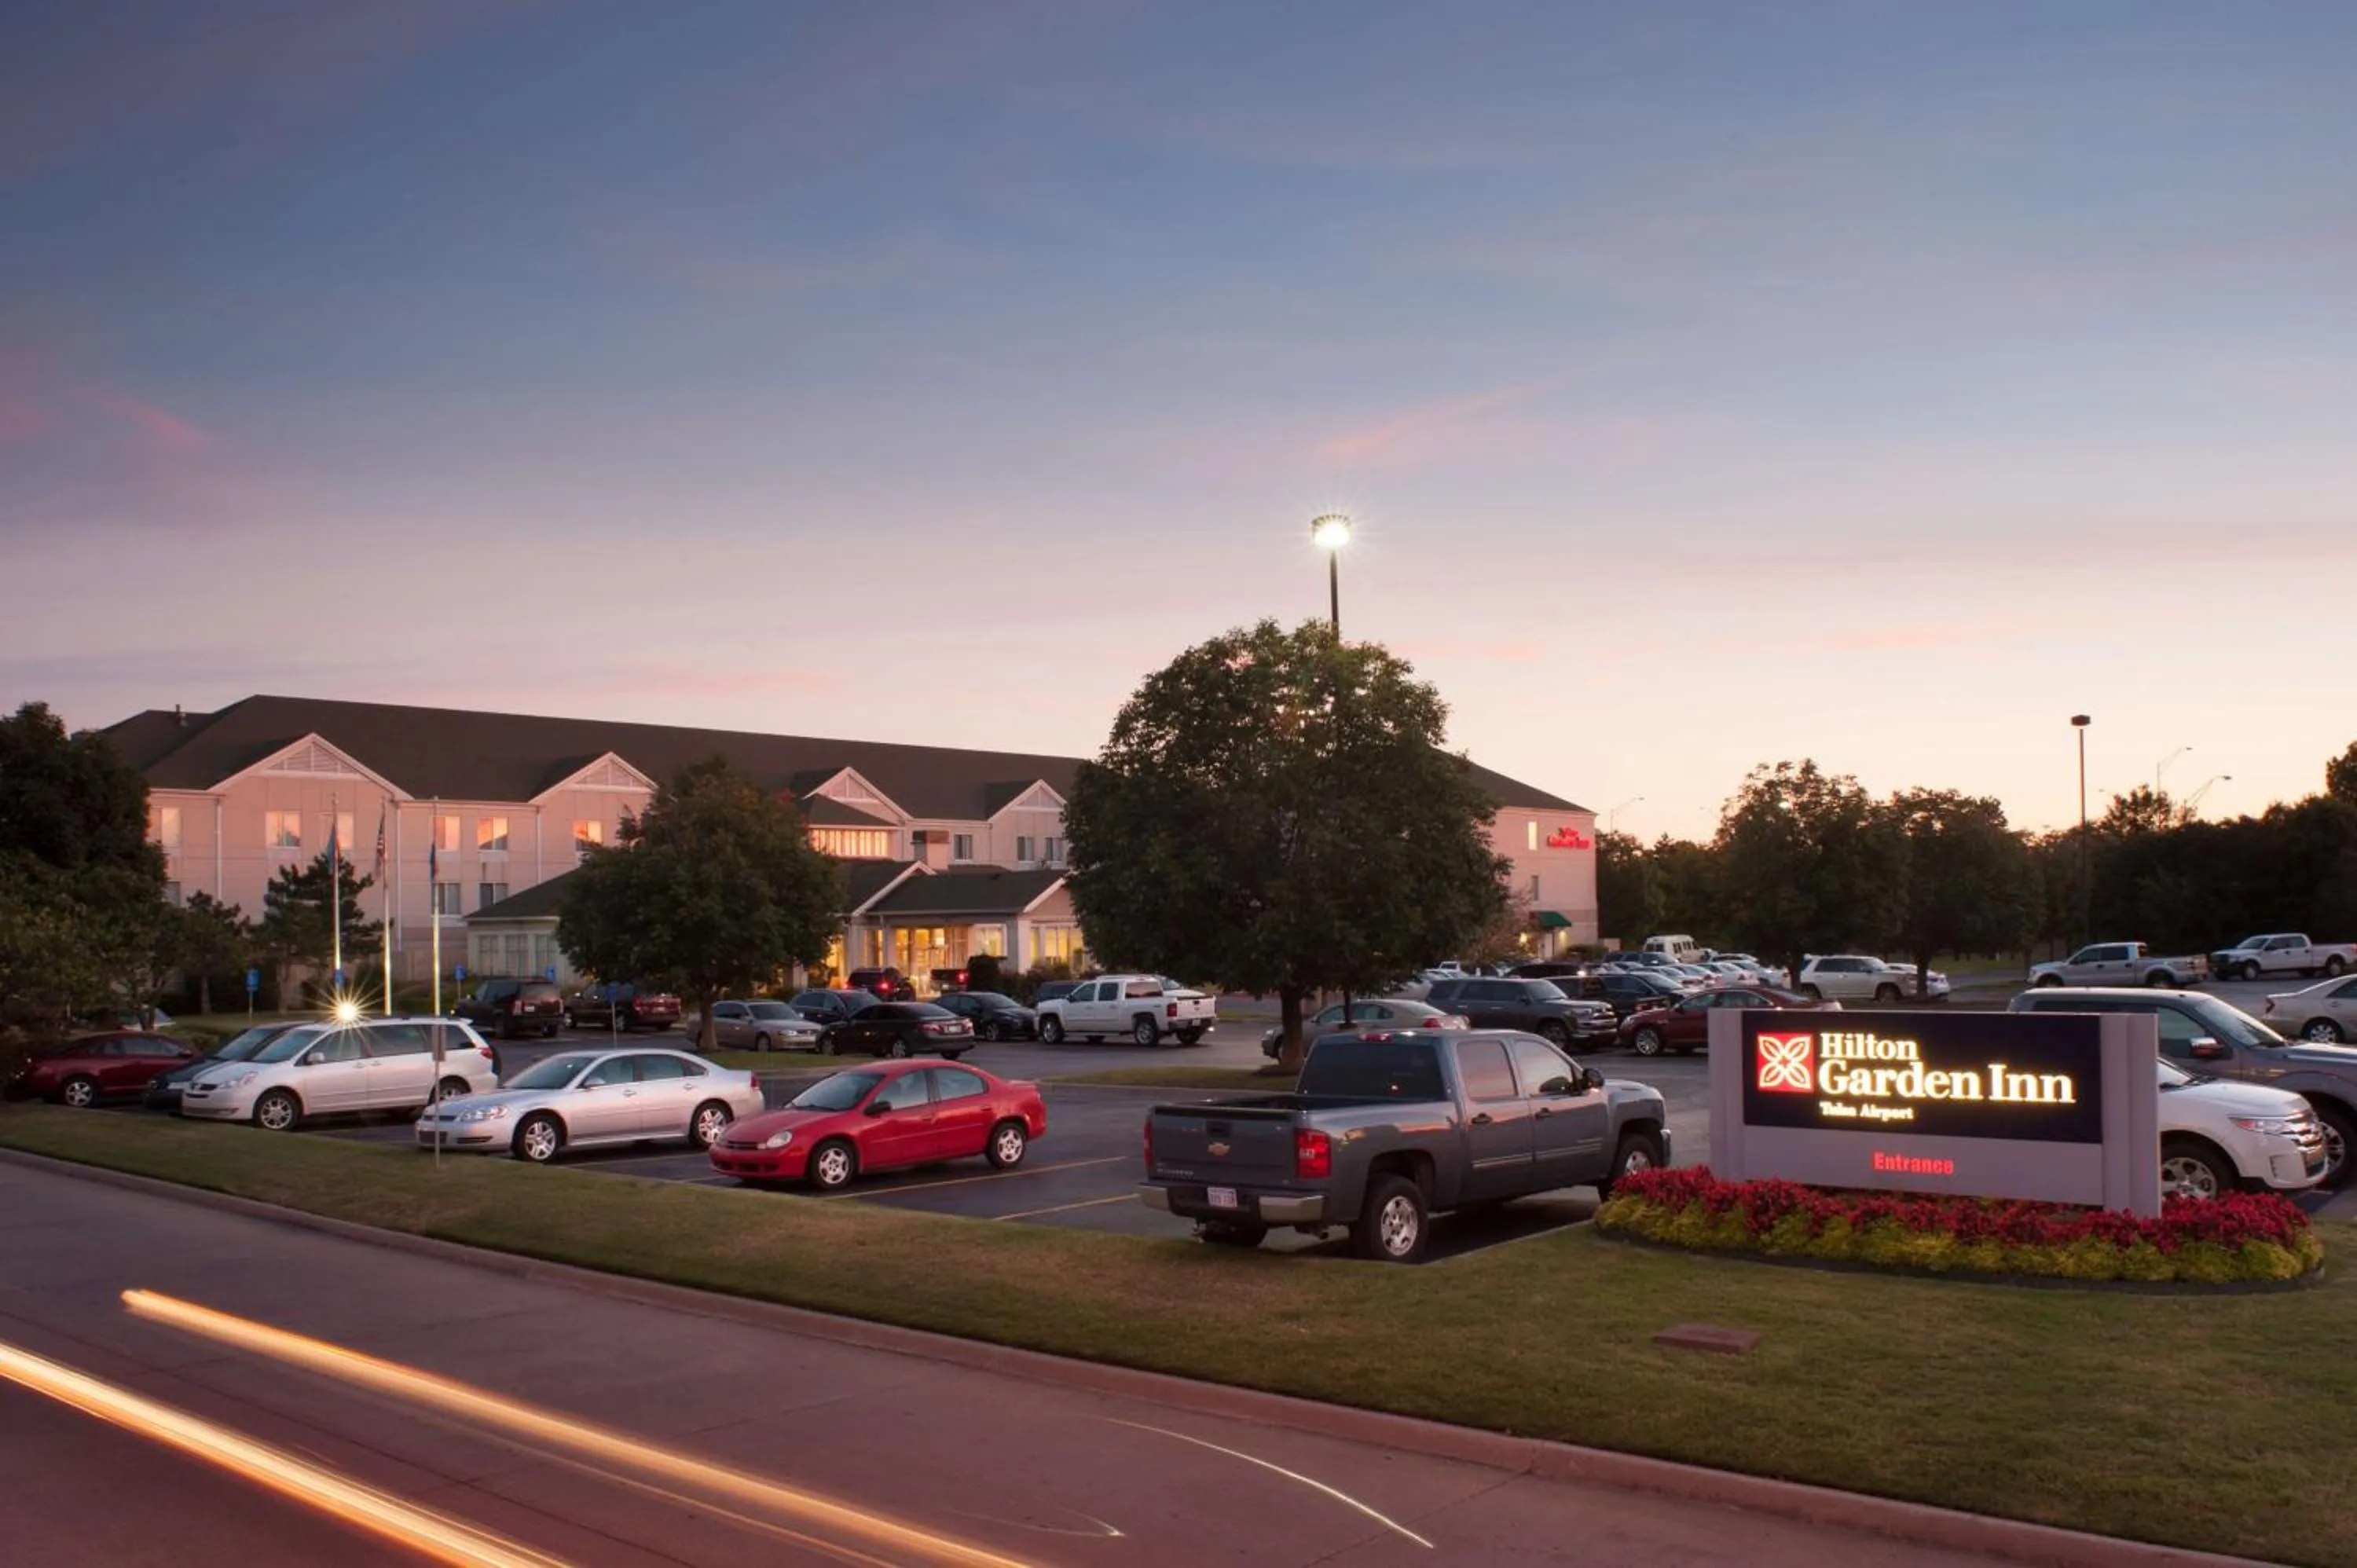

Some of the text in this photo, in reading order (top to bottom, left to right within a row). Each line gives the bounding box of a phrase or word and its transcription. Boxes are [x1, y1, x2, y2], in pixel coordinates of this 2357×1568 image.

[1820, 1032, 1919, 1061] Hilton
[1818, 1059, 2077, 1104] Garden Inn
[1860, 1103, 1914, 1122] Airport
[1873, 1151, 1954, 1174] Entrance
